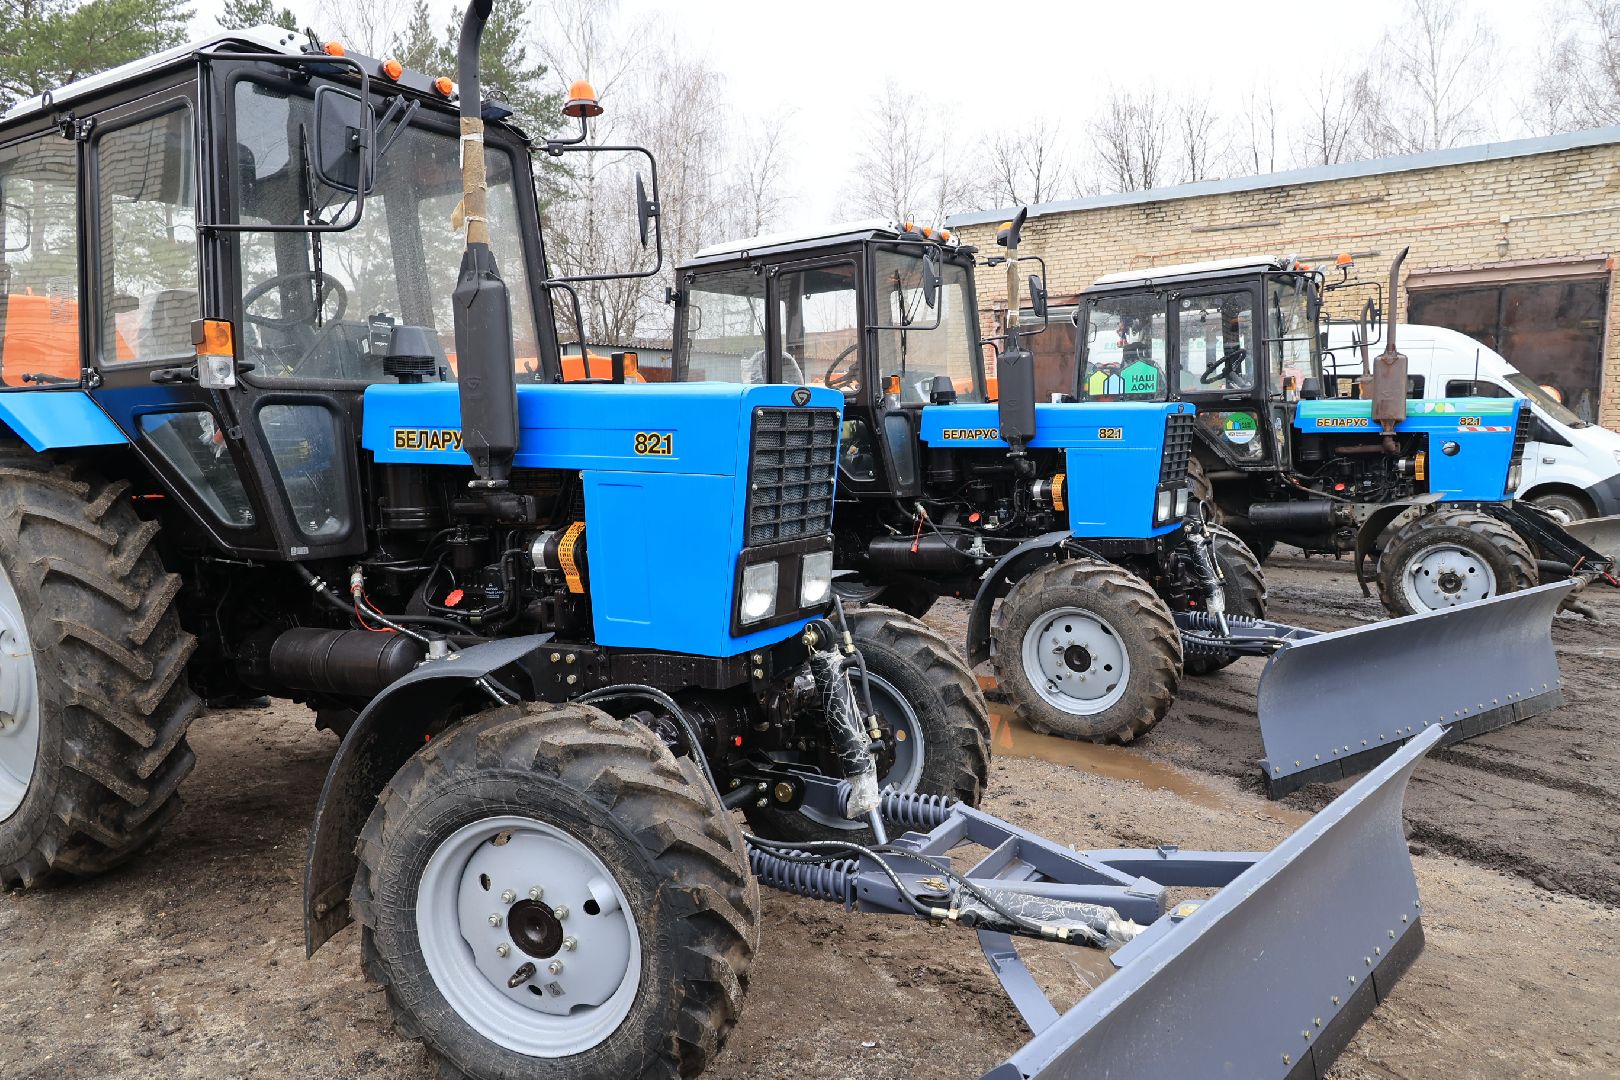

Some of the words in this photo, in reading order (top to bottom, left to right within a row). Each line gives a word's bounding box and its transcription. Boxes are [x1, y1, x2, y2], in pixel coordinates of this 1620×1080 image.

[1131, 374, 1155, 383] НАШ
[1131, 383, 1155, 391] ДОМ
[1316, 418, 1368, 427] БЕЛАРУС
[1460, 416, 1481, 426] 82.1
[943, 429, 998, 440] БЕЛАРУС
[1098, 428, 1122, 439] 82.1
[394, 430, 462, 449] БЕЛАРУ
[634, 433, 672, 455] 82.1
